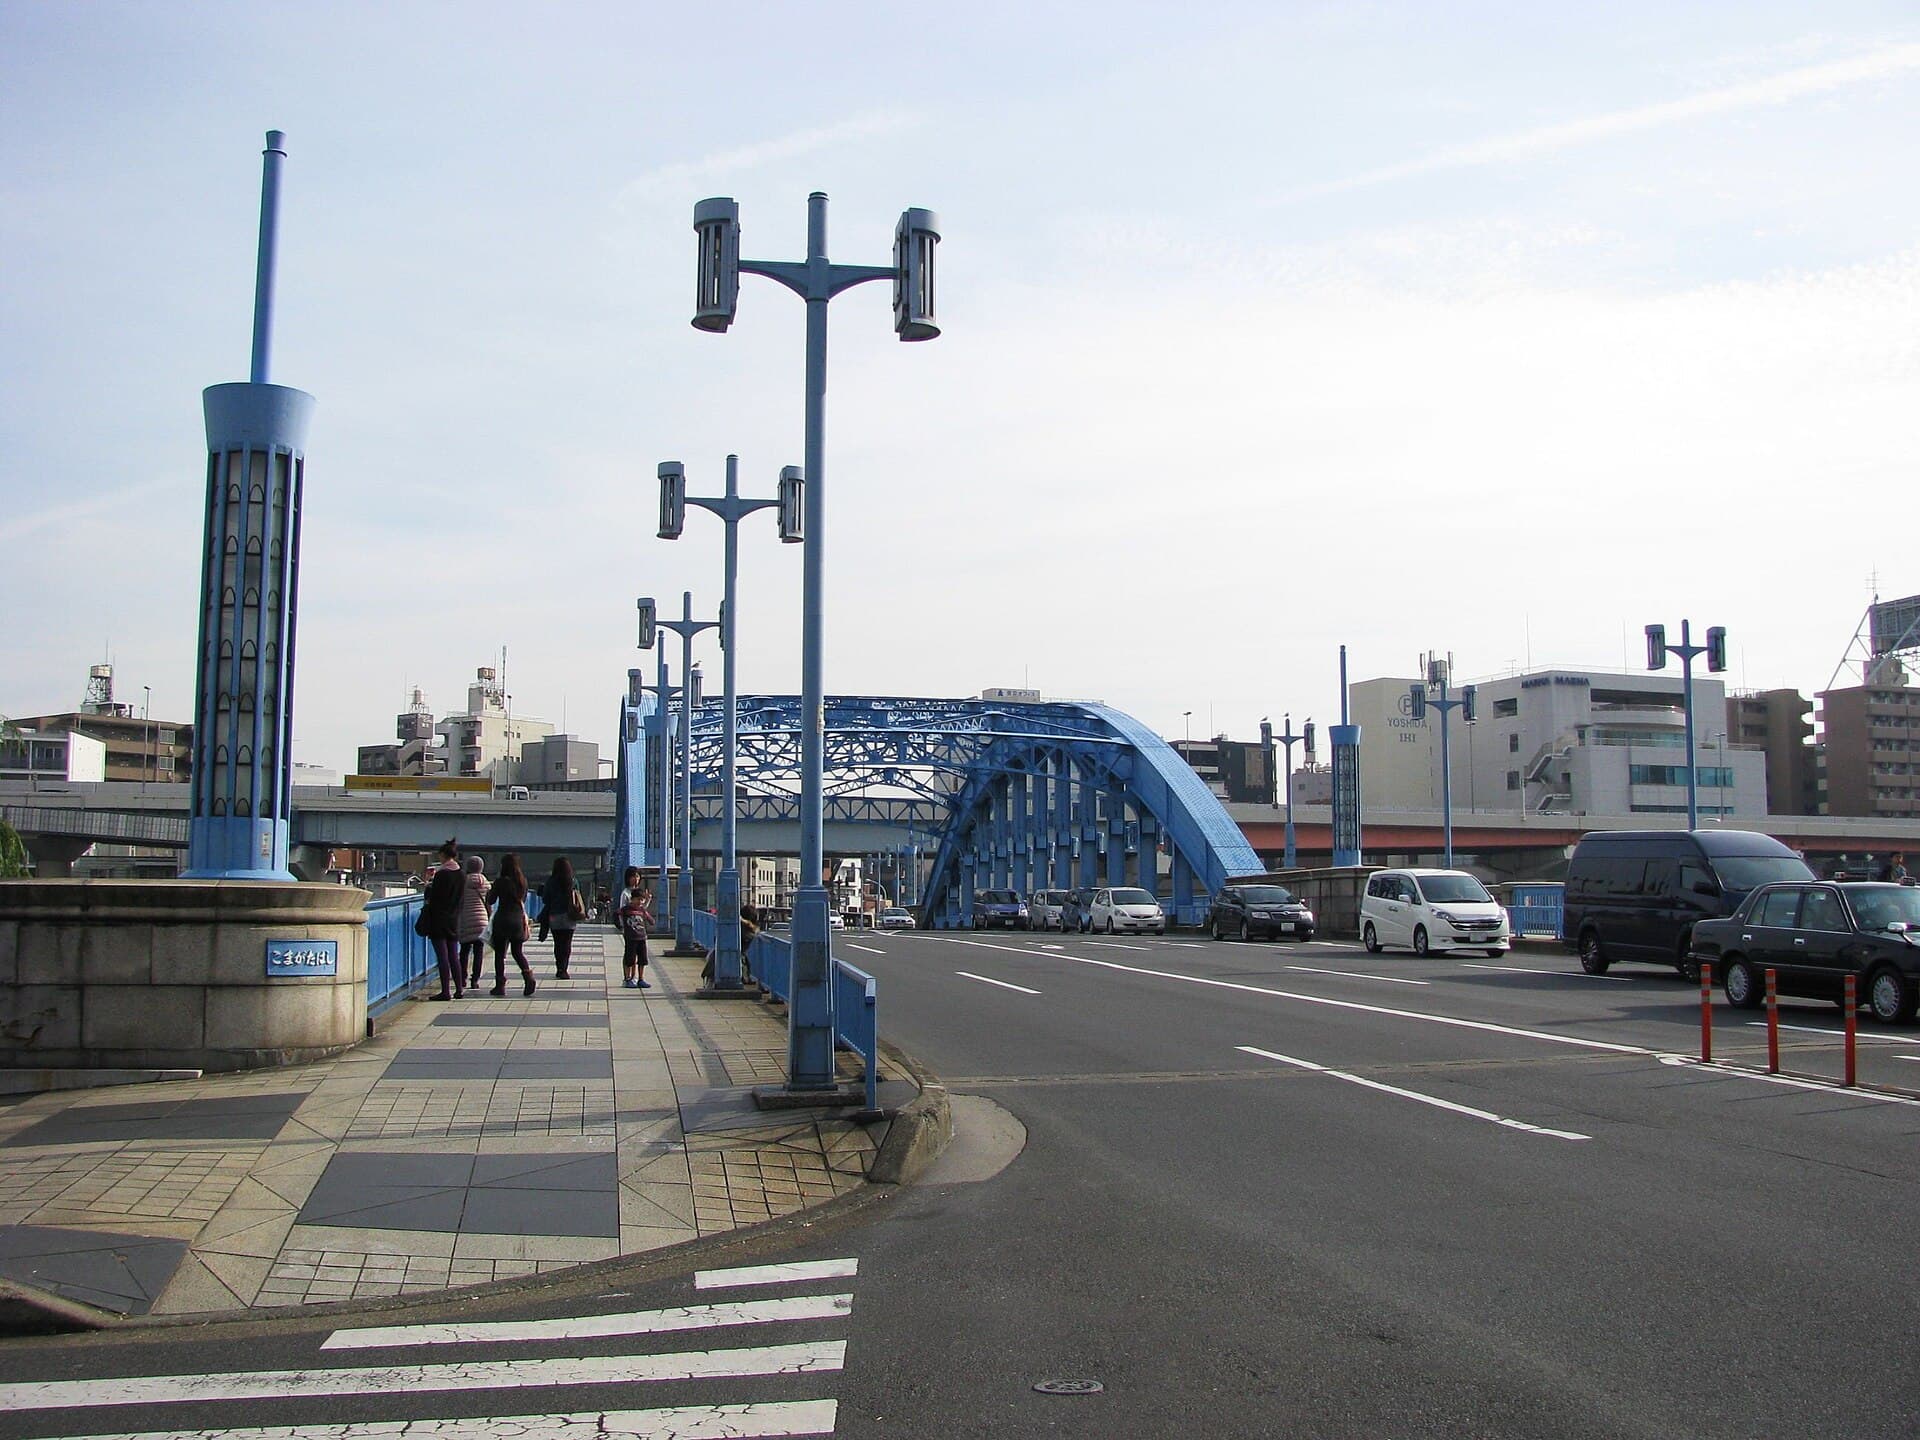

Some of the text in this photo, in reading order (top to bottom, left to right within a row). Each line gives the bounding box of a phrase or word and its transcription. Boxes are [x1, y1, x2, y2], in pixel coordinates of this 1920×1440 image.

[1387, 717, 1427, 728] YOSHIDA
[1399, 733, 1416, 743] IHI
[272, 949, 335, 966] こまがたはし
